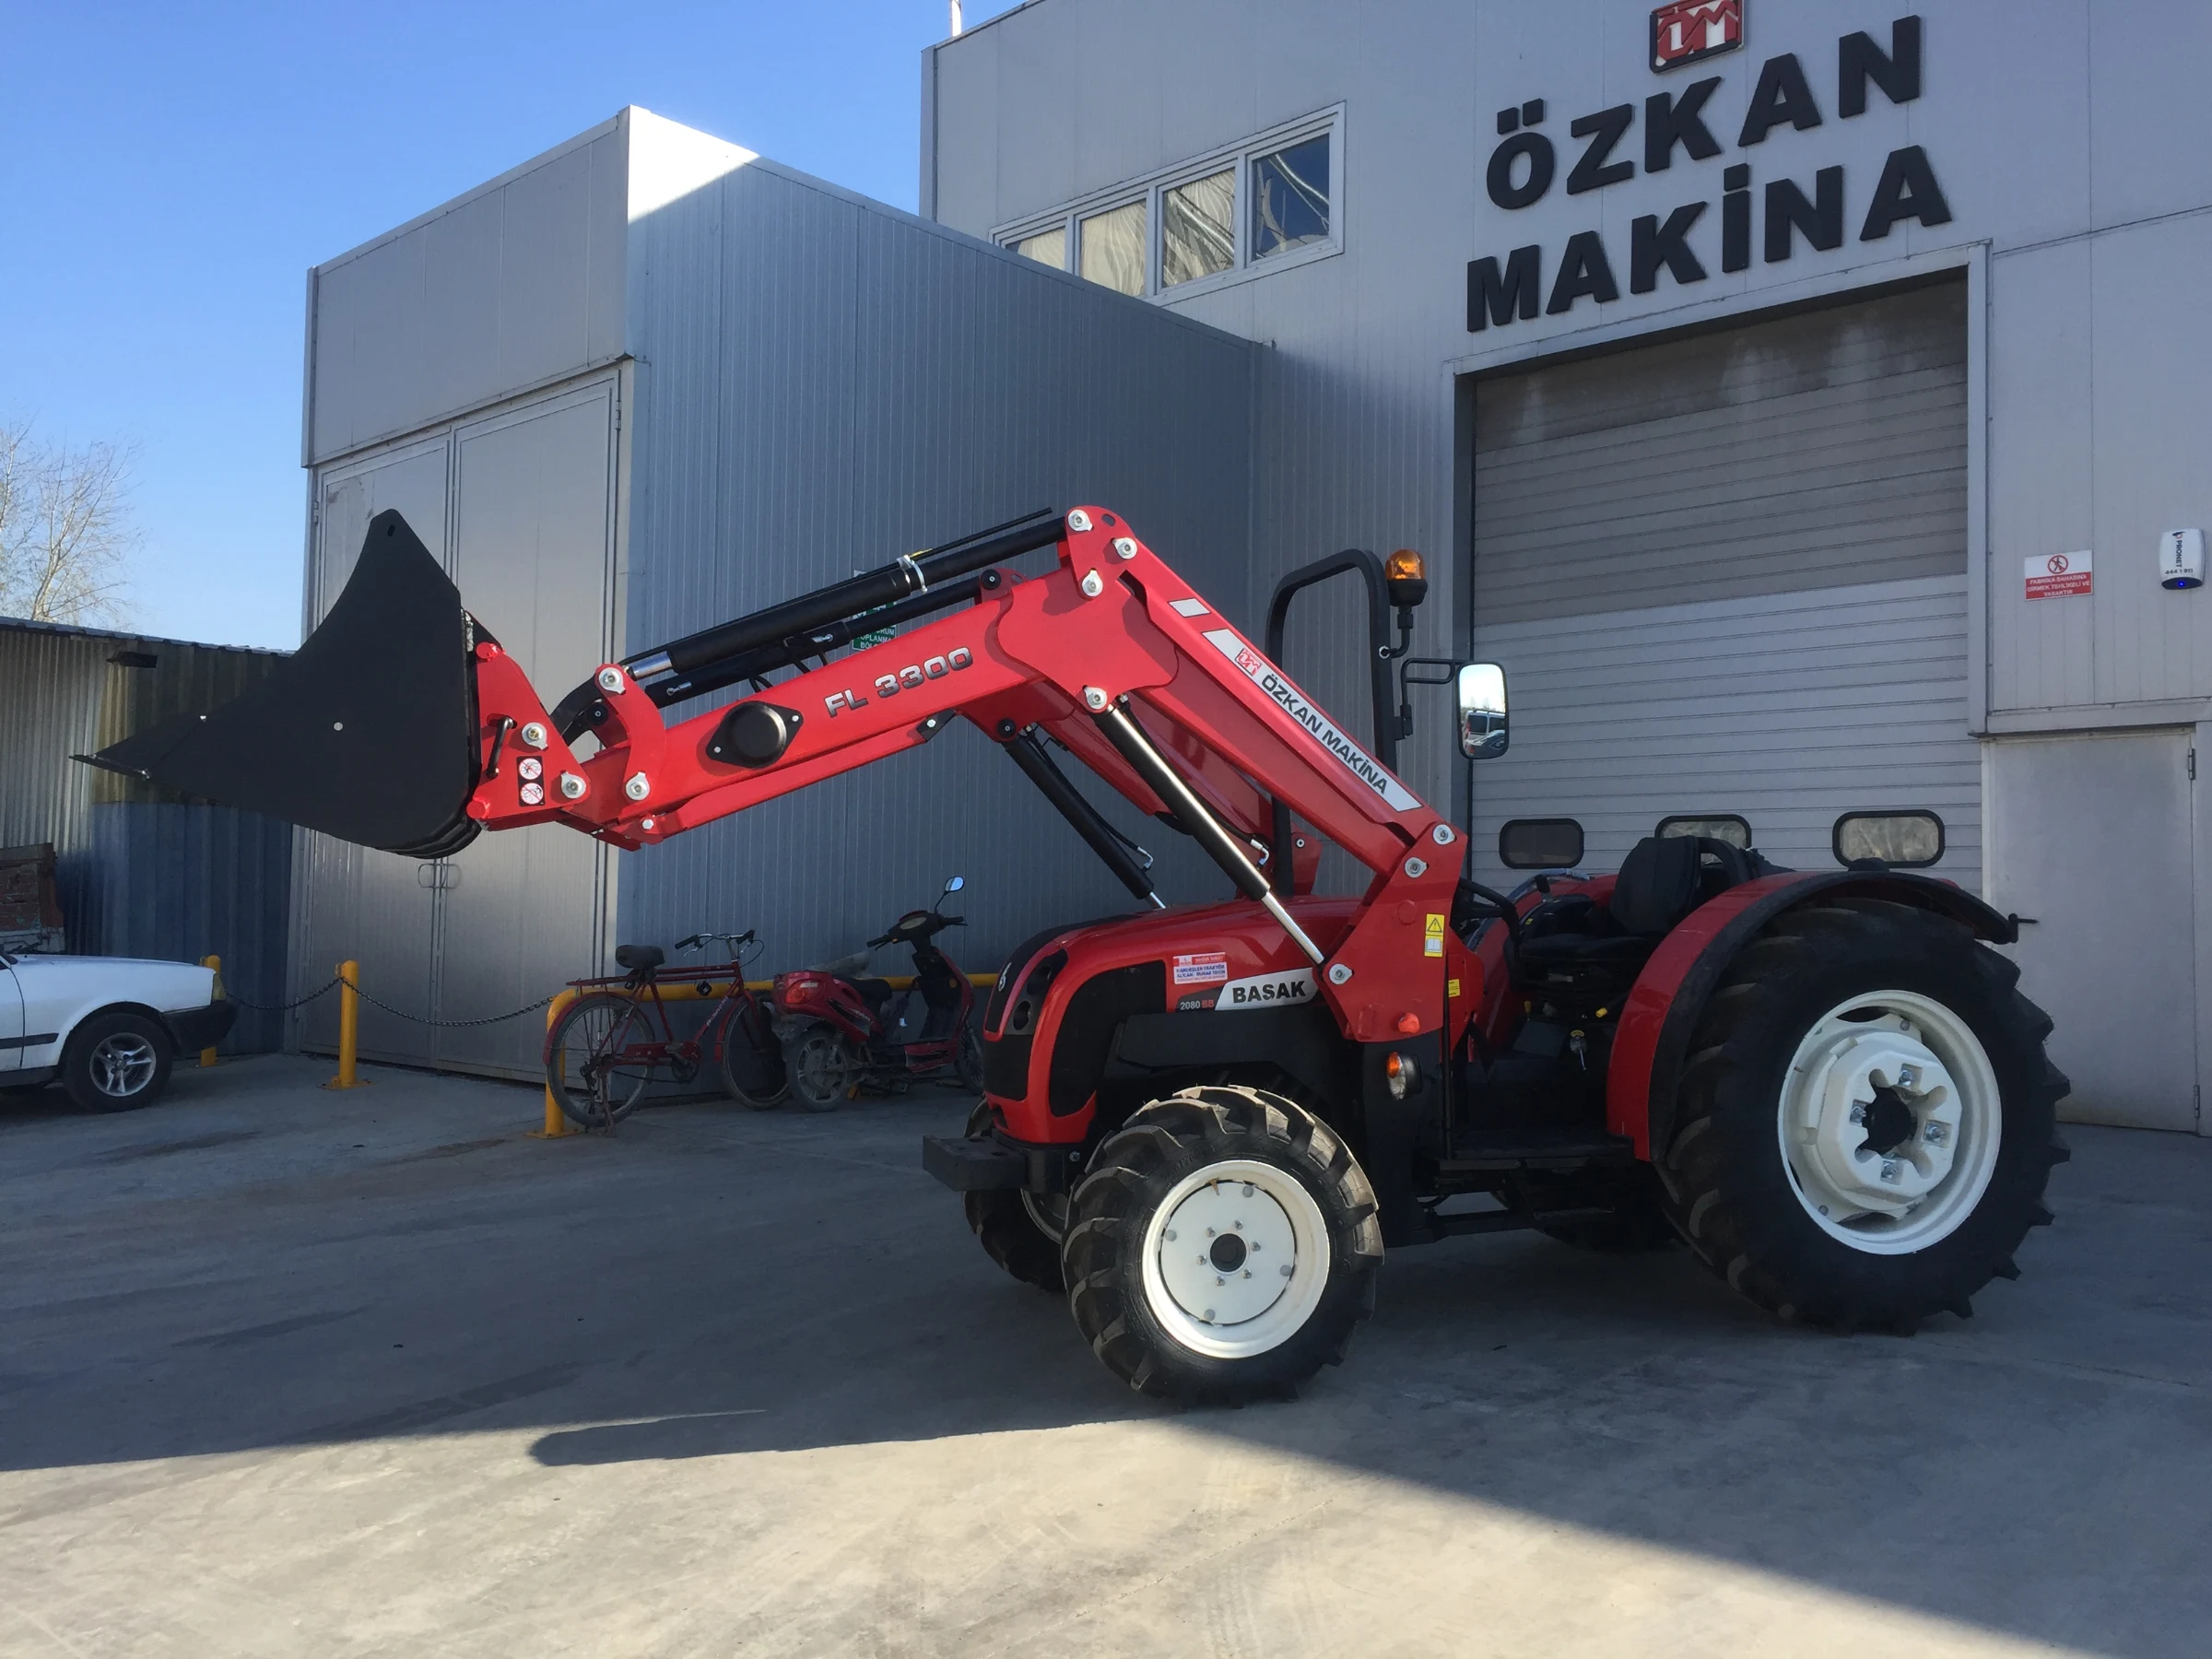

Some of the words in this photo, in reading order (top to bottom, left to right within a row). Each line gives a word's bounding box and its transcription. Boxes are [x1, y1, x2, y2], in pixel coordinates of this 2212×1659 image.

[1486, 14, 1922, 211] ÖZKAN
[1466, 144, 1953, 333] MAKİNA
[823, 688, 869, 718] FL
[874, 646, 974, 699] 3300
[1260, 673, 1324, 734] ÖZKAN
[1321, 729, 1389, 795] MAKİNA
[1180, 1001, 1201, 1011] 2080
